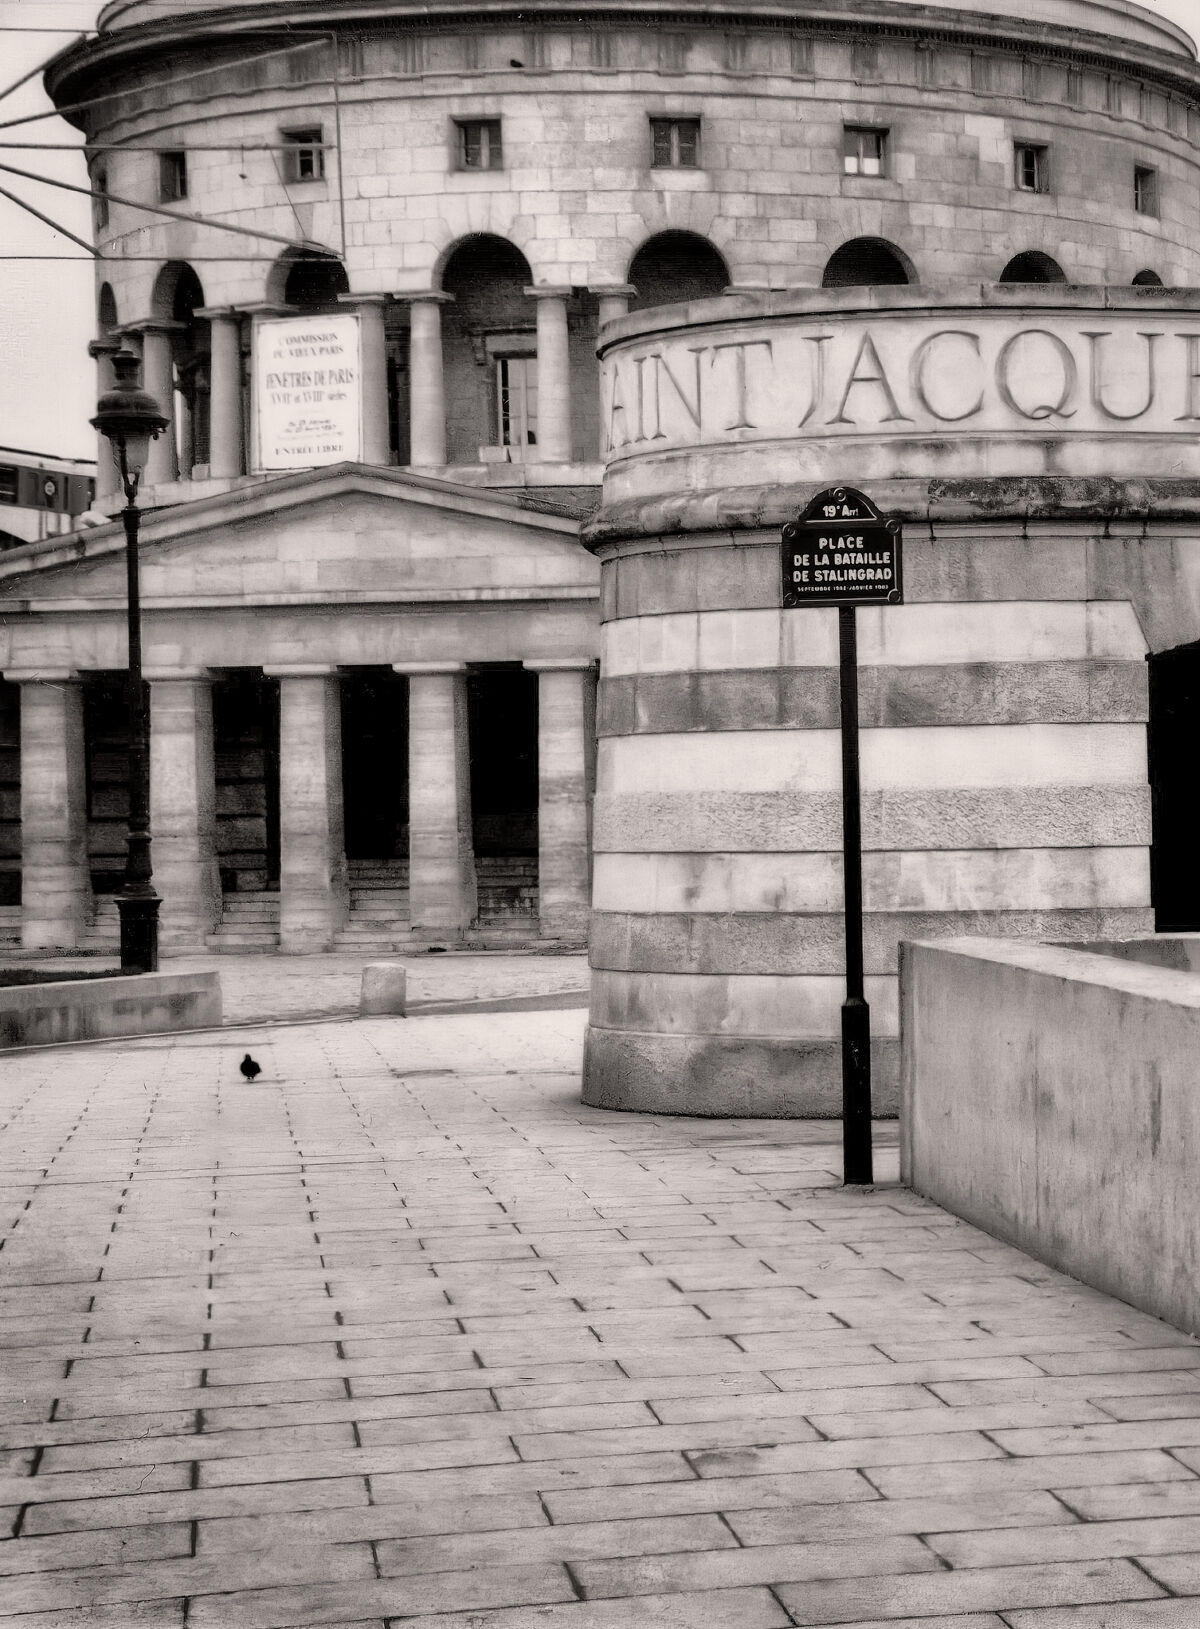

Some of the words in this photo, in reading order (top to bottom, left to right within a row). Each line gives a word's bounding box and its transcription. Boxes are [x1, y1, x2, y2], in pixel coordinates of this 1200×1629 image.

[328, 367, 354, 384] PARIS
[605, 339, 775, 452] AINT
[818, 536, 864, 549] PLACE
[793, 554, 810, 566] DE
[814, 553, 830, 566] LA
[834, 552, 891, 565] BATAILLE
[793, 570, 810, 582] DE
[814, 568, 892, 581] STALINGRAD
